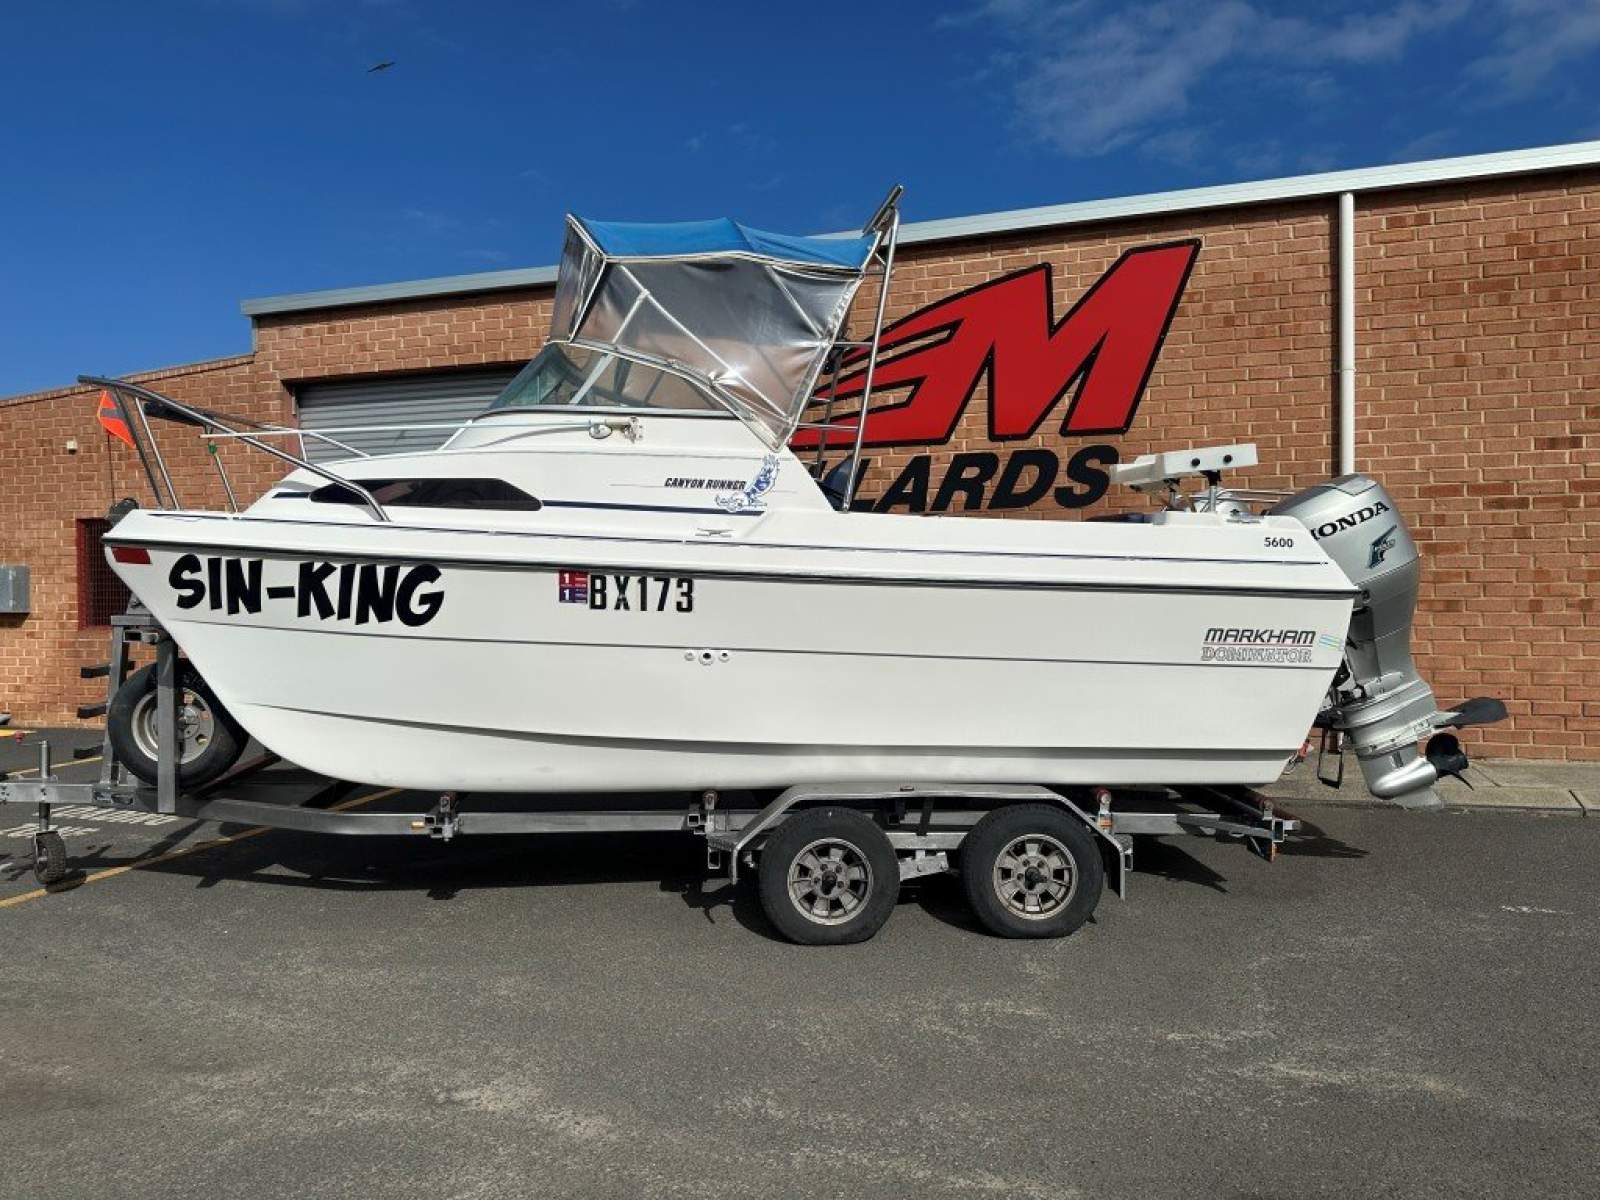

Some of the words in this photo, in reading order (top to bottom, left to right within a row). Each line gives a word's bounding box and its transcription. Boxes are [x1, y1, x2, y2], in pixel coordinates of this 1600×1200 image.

[664, 477, 705, 489] CANYON
[706, 478, 748, 491] RUNNER
[1264, 537, 1294, 548] 5600
[169, 554, 444, 627] SIN-KING
[590, 575, 695, 613] BX173
[1205, 627, 1316, 644] MARKHAM
